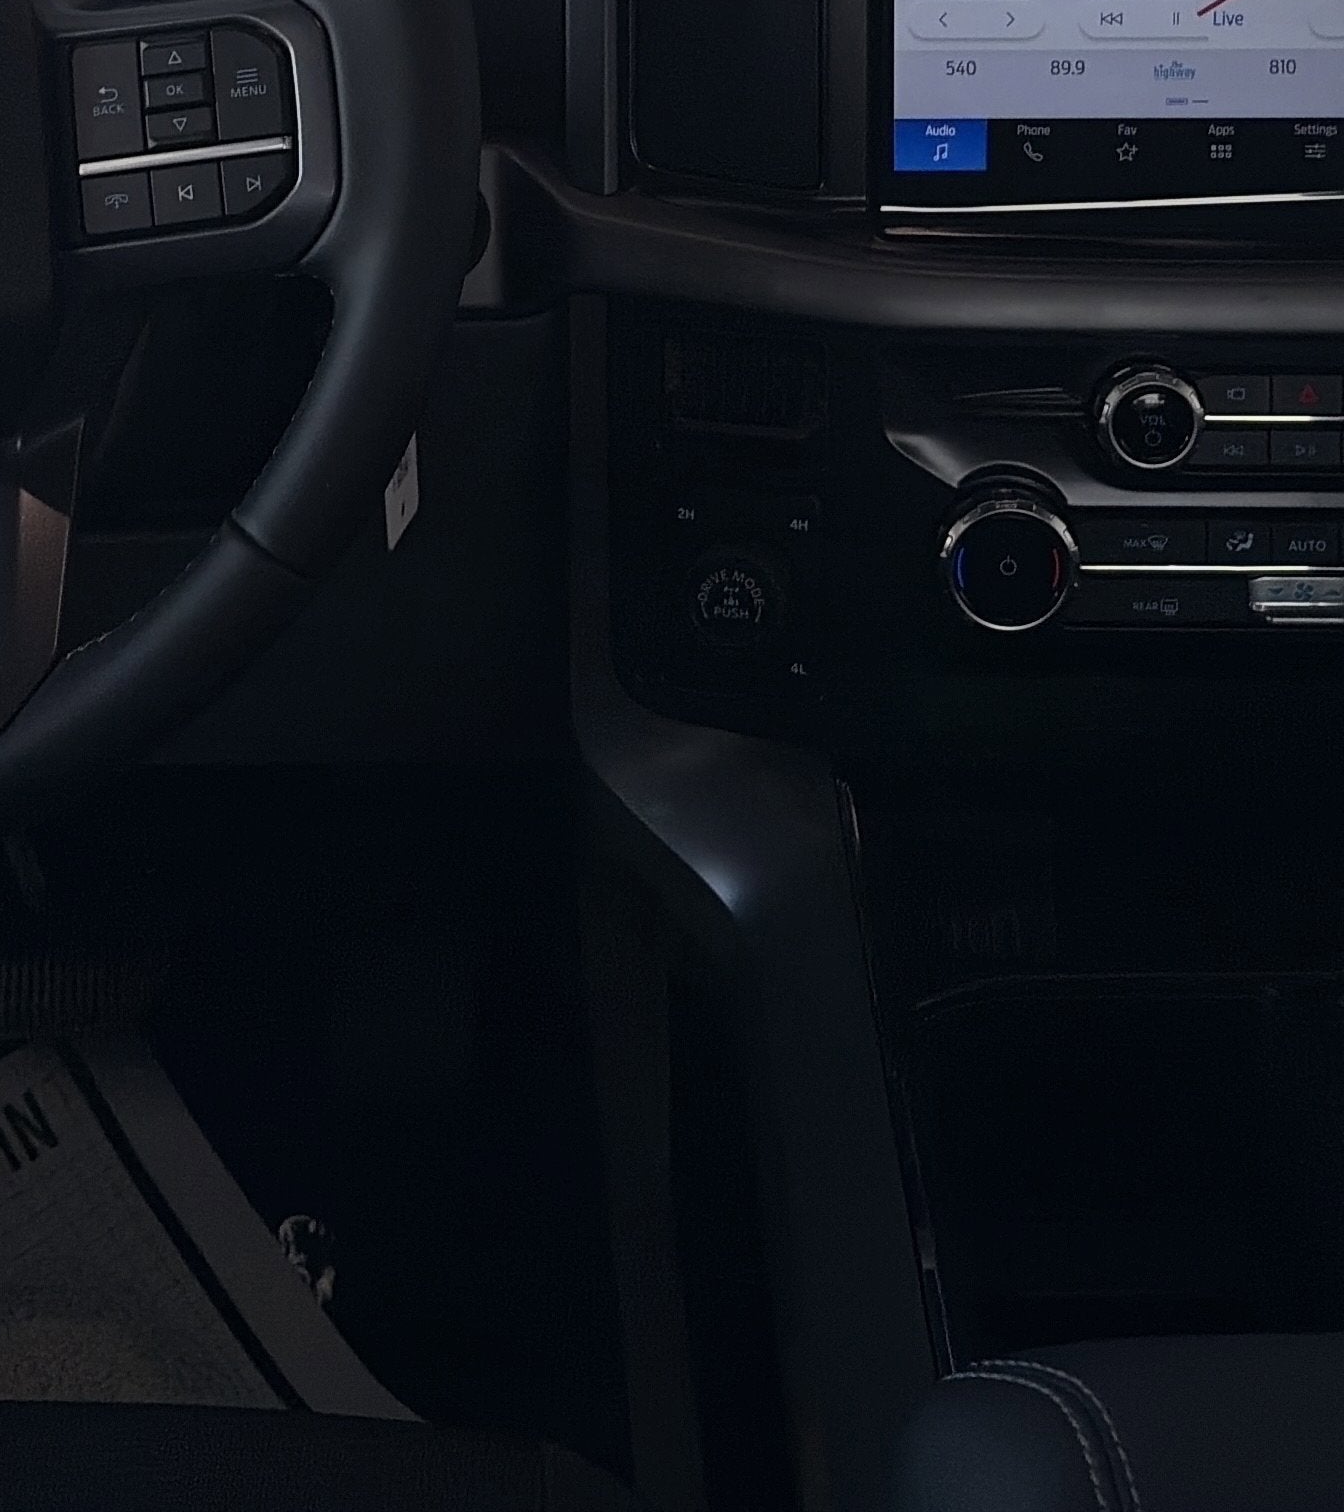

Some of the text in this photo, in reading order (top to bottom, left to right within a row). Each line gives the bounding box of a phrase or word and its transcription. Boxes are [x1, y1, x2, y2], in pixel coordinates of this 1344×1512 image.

[1212, 11, 1244, 26] Live
[946, 60, 977, 76] 540
[1050, 60, 1085, 76] 89.9
[1269, 60, 1297, 76] 810
[166, 84, 185, 97] OK
[230, 84, 267, 99] MENU
[92, 103, 125, 117] BACK
[925, 123, 956, 137] Audio
[1017, 123, 1051, 136] Phone
[1117, 123, 1137, 136] Fav
[1207, 123, 1235, 138] Apps
[1294, 123, 1338, 138] Settings
[677, 508, 696, 521] 2H
[789, 518, 809, 532] 4H
[1122, 538, 1147, 549] MAX
[1288, 539, 1327, 552] AUTO
[696, 569, 766, 606] DRIVE MODE
[713, 606, 750, 620] PUSH
[789, 662, 808, 675] 4L
